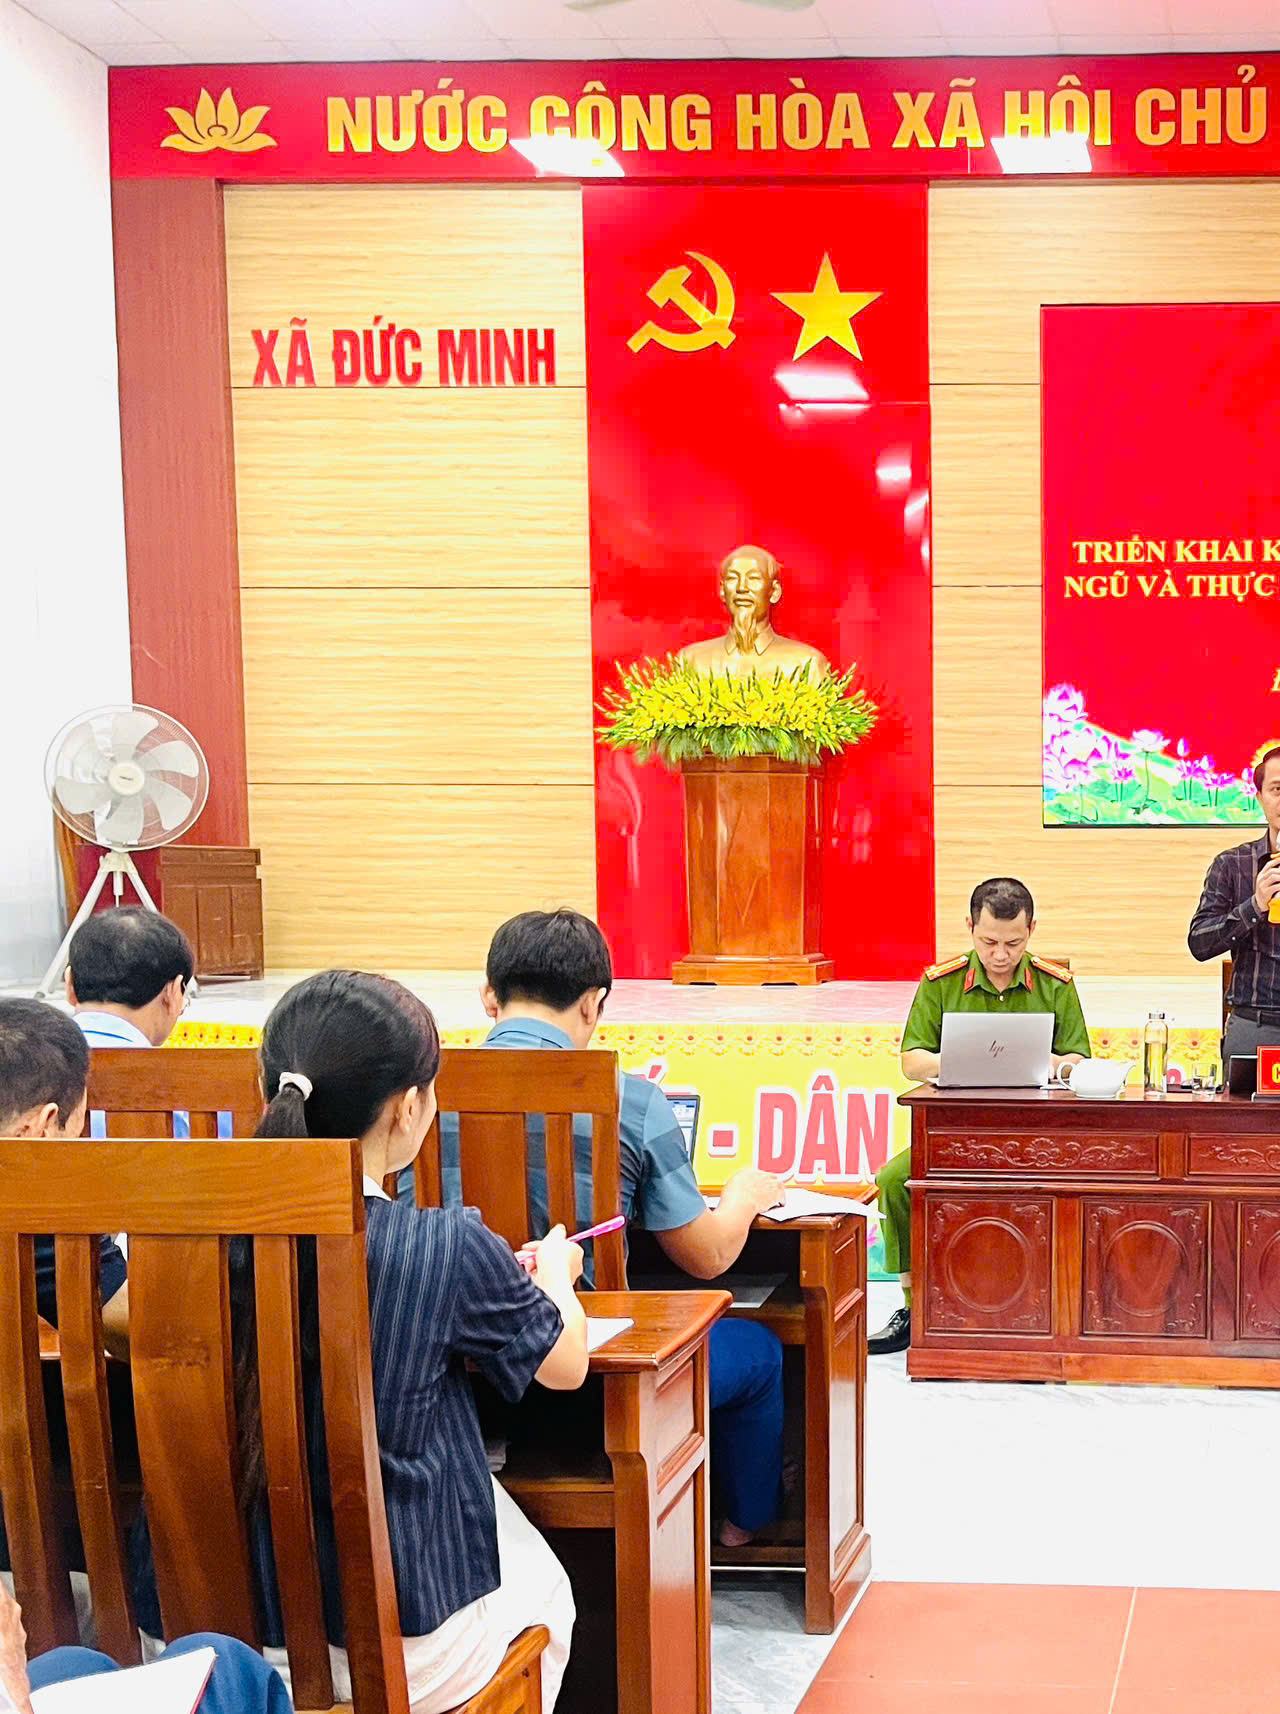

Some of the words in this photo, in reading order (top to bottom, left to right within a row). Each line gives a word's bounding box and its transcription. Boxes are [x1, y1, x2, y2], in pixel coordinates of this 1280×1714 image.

[327, 78, 507, 153] NƯỚC
[529, 81, 712, 166] CỘNG
[736, 78, 870, 150] HÒA
[892, 77, 984, 149] XÃ
[1136, 65, 1266, 145] CHỦ
[251, 317, 316, 386] XÃ
[332, 316, 422, 386] ĐỨC
[437, 328, 556, 386] MINH
[1073, 536, 1165, 562] TRIỂN
[1176, 540, 1252, 562] KHAI
[1065, 571, 1128, 597] NGŨ
[1138, 570, 1179, 596] VÀ
[1187, 572, 1274, 601] THỰC
[757, 1075, 889, 1175] DÂN
